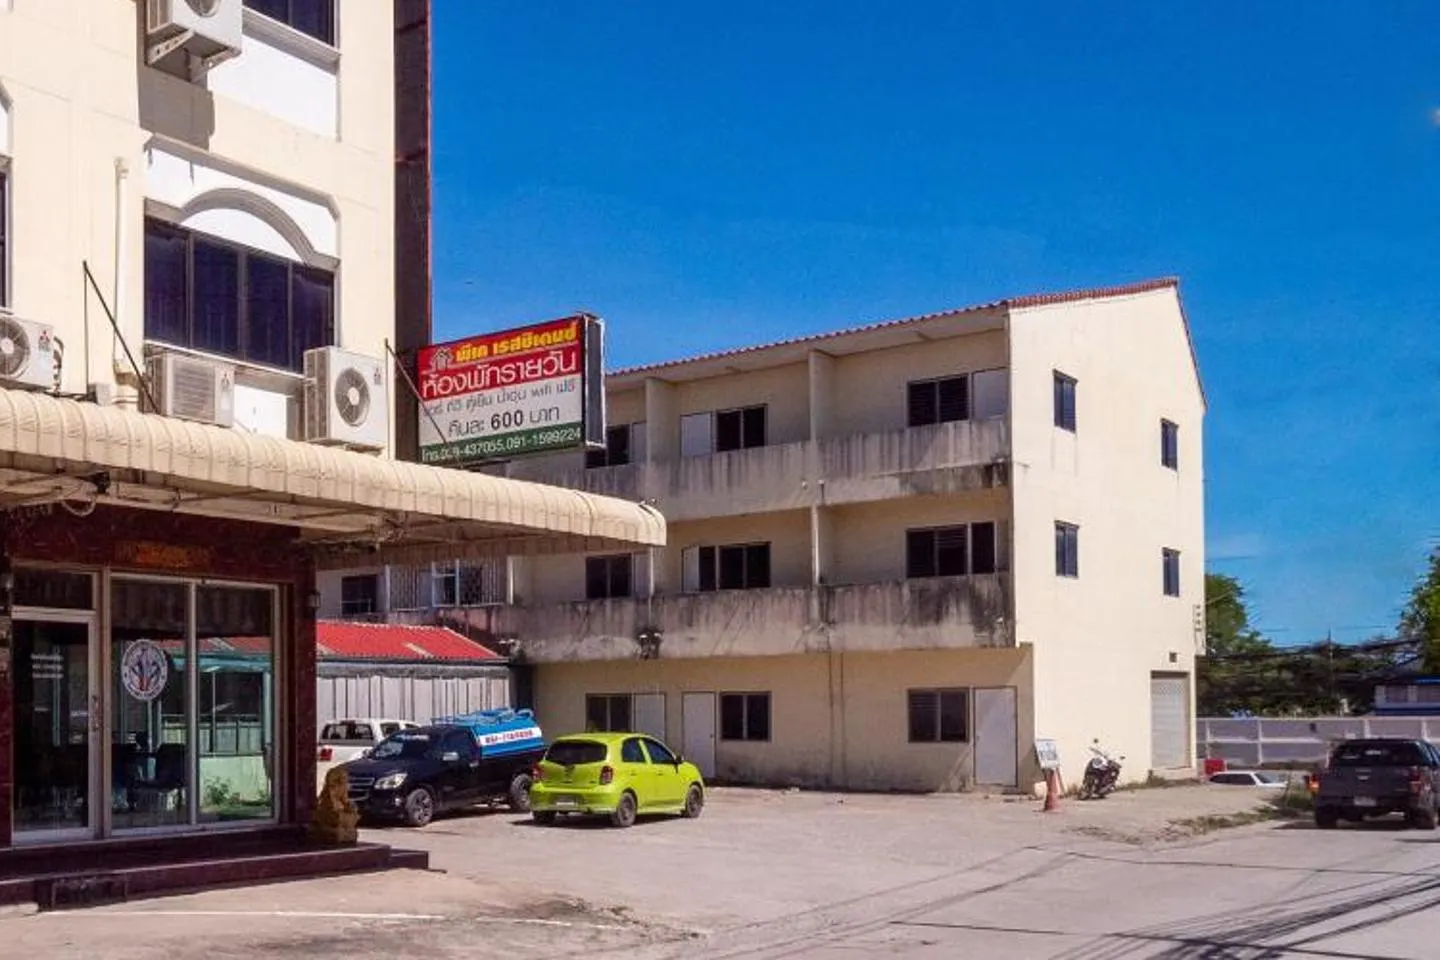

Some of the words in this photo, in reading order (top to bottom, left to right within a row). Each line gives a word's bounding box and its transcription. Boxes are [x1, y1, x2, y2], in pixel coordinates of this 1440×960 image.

[422, 350, 577, 398] ห้องพักรายวัน
[490, 409, 524, 431] 600
[529, 405, 560, 424] บาท
